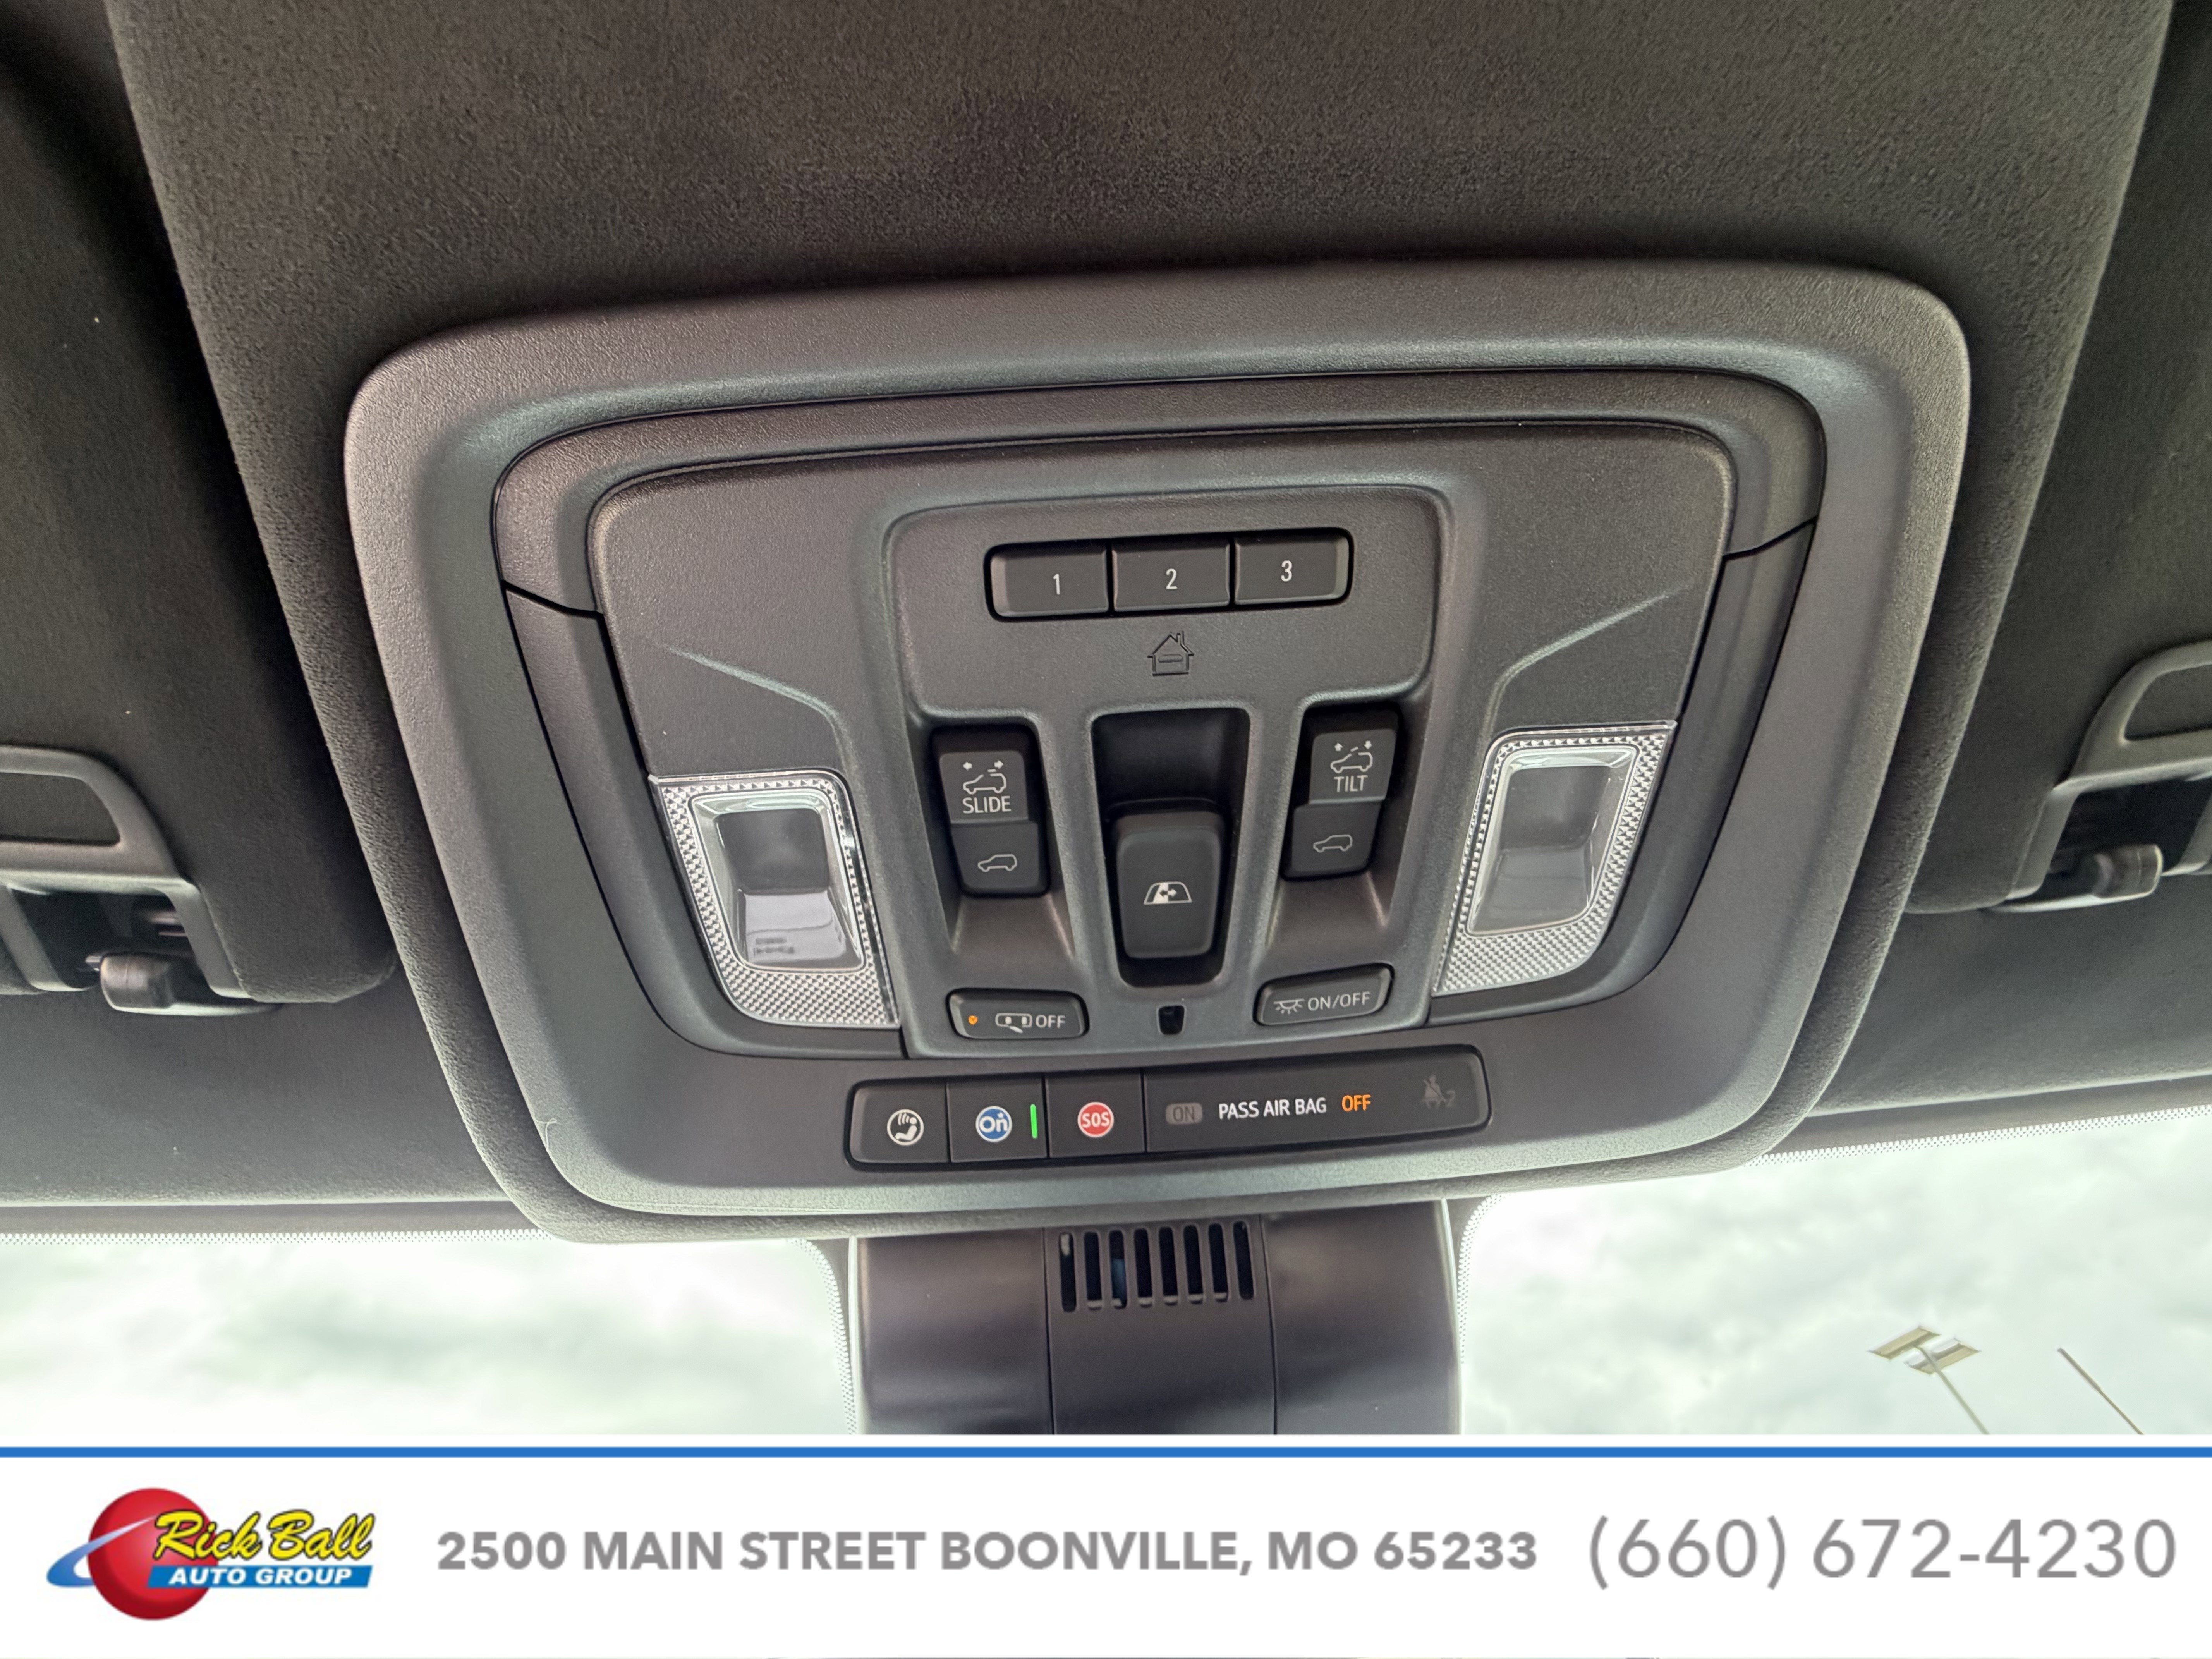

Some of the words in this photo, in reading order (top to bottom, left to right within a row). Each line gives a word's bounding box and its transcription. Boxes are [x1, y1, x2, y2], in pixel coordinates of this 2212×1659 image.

[1166, 568, 1178, 590] 2
[1280, 560, 1293, 582] 3
[1053, 573, 1061, 595] 1
[1334, 775, 1368, 792] TILT
[962, 795, 1012, 814] SLIDE
[1307, 991, 1370, 1011] ON/OFF
[1035, 1014, 1065, 1028] OFF
[1173, 1106, 1195, 1121] ON
[1218, 1101, 1260, 1120] PASS
[1263, 1099, 1290, 1117] AIR
[1295, 1097, 1327, 1115] BAG
[1341, 1094, 1371, 1112] OFF
[979, 1112, 1008, 1133] On
[1082, 1112, 1110, 1128] SOS
